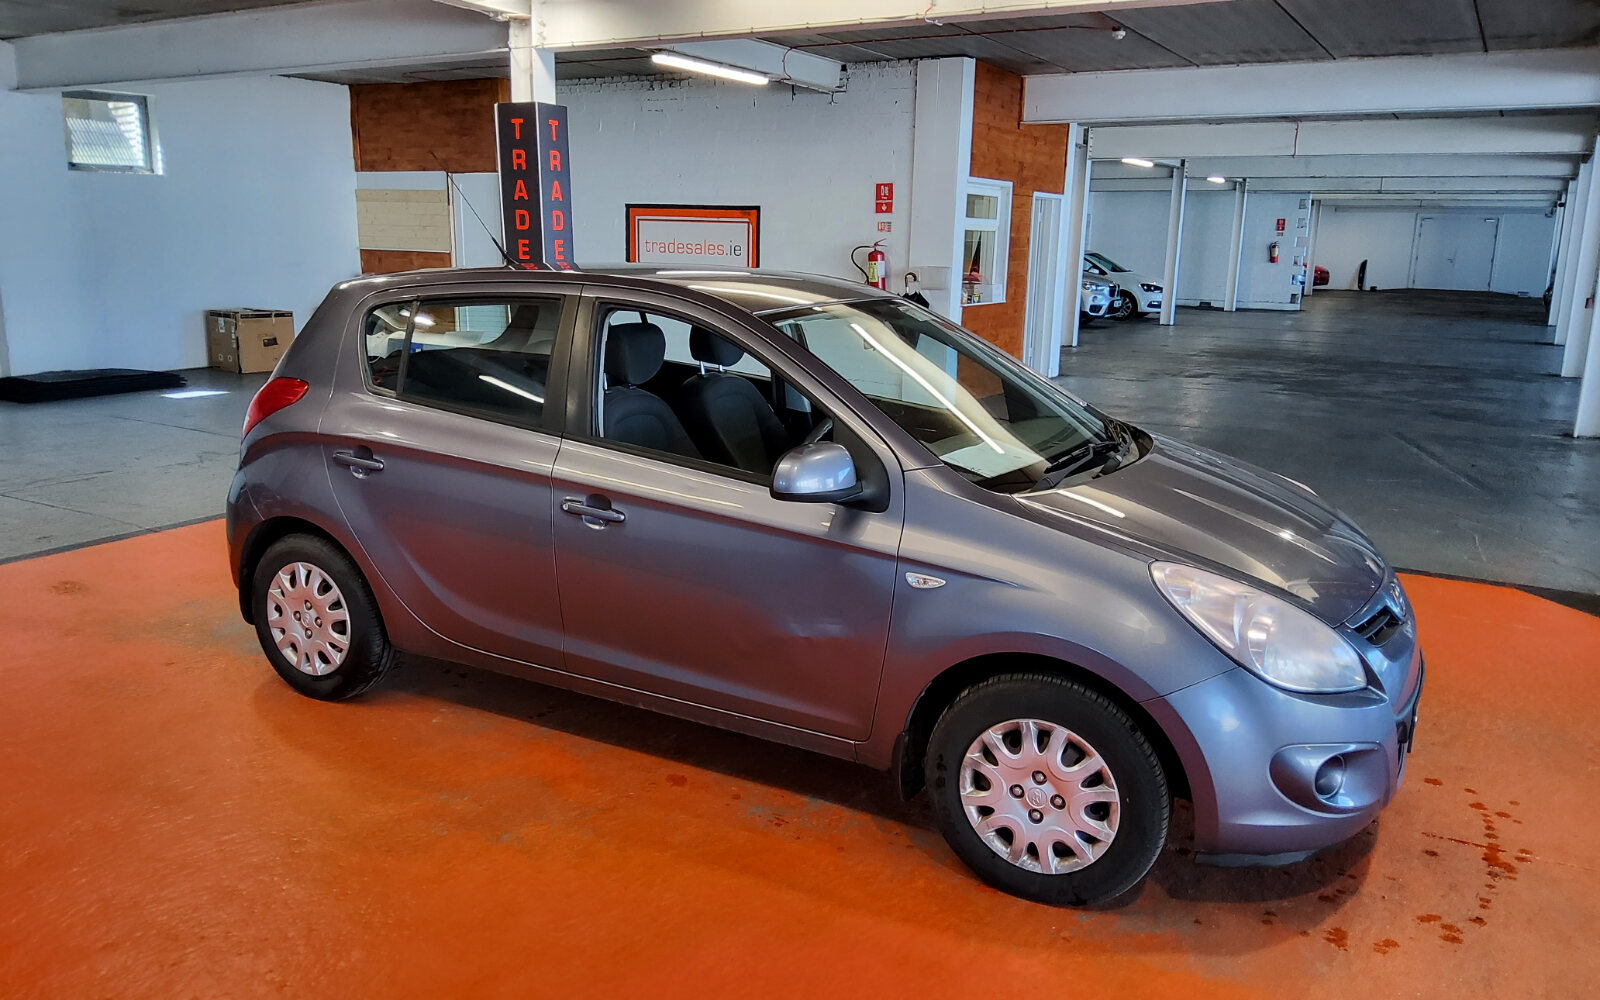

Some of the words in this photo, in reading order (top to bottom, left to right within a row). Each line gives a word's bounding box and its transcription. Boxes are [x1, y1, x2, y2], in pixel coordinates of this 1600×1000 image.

[510, 118, 531, 260] TRADE
[548, 119, 565, 260] TRADE
[644, 238, 742, 257] tradesales.ie
